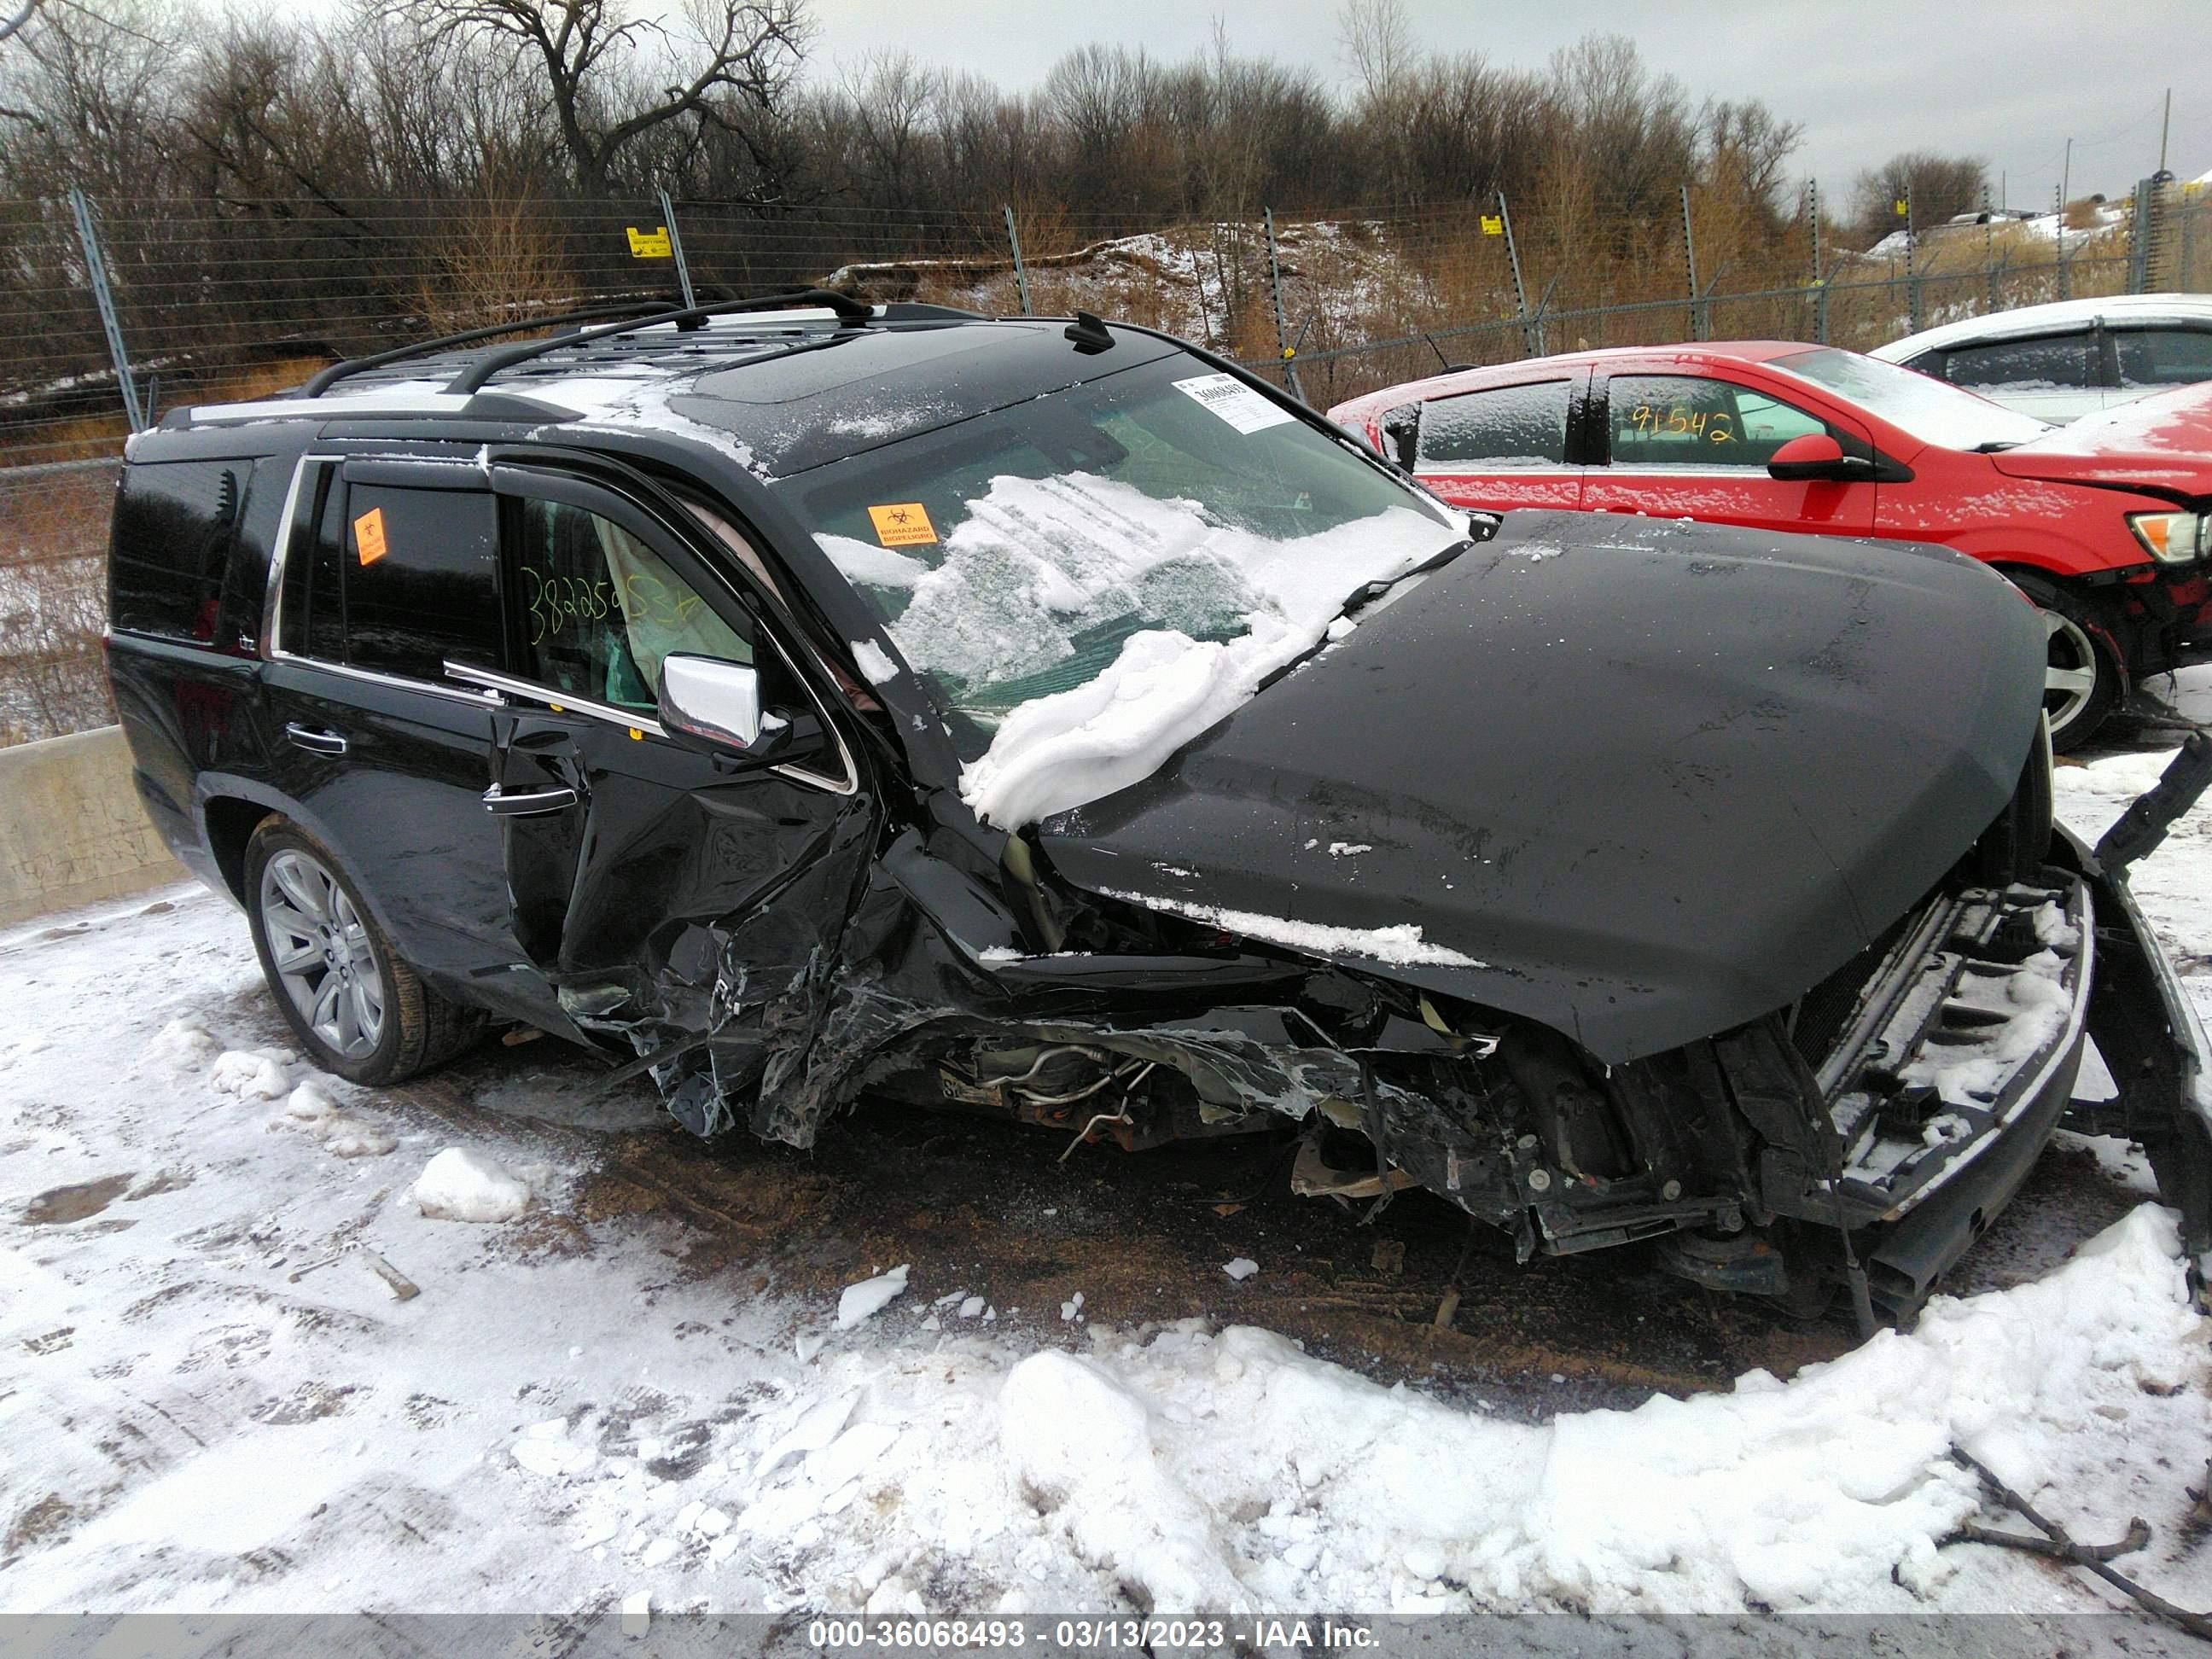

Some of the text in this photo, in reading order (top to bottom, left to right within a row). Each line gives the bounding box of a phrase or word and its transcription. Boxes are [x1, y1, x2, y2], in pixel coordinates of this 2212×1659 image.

[1194, 383, 1248, 402] 36068493
[1632, 406, 1738, 444] 91542
[880, 526, 929, 535] BIOHAZARD
[883, 533, 934, 543] BIOPELIGRO
